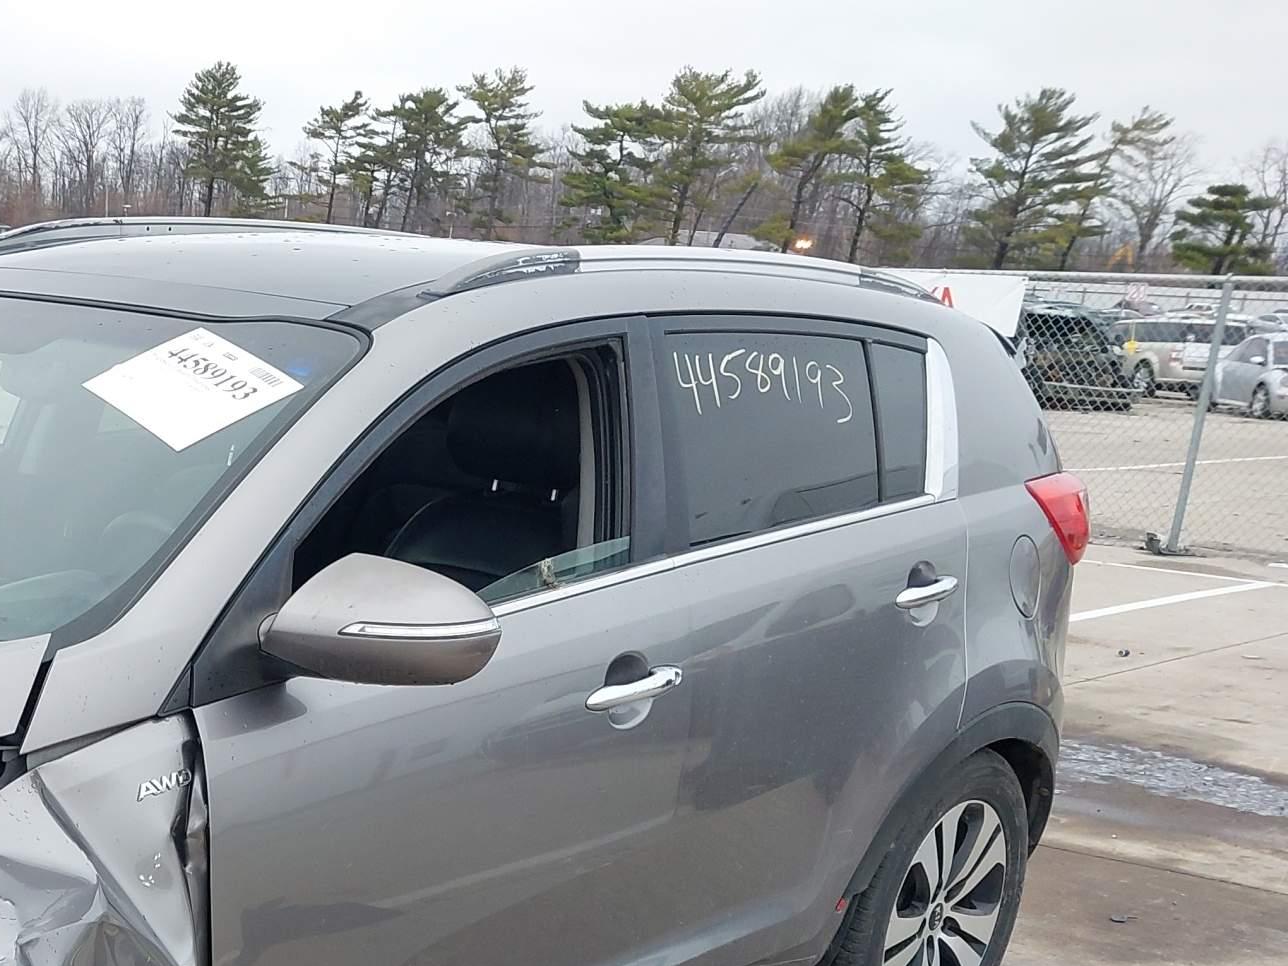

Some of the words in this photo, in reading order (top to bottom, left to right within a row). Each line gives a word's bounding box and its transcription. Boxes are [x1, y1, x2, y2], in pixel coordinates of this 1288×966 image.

[168, 347, 258, 400] 44589193
[672, 349, 854, 424] 44589193
[136, 767, 192, 802] AWD
